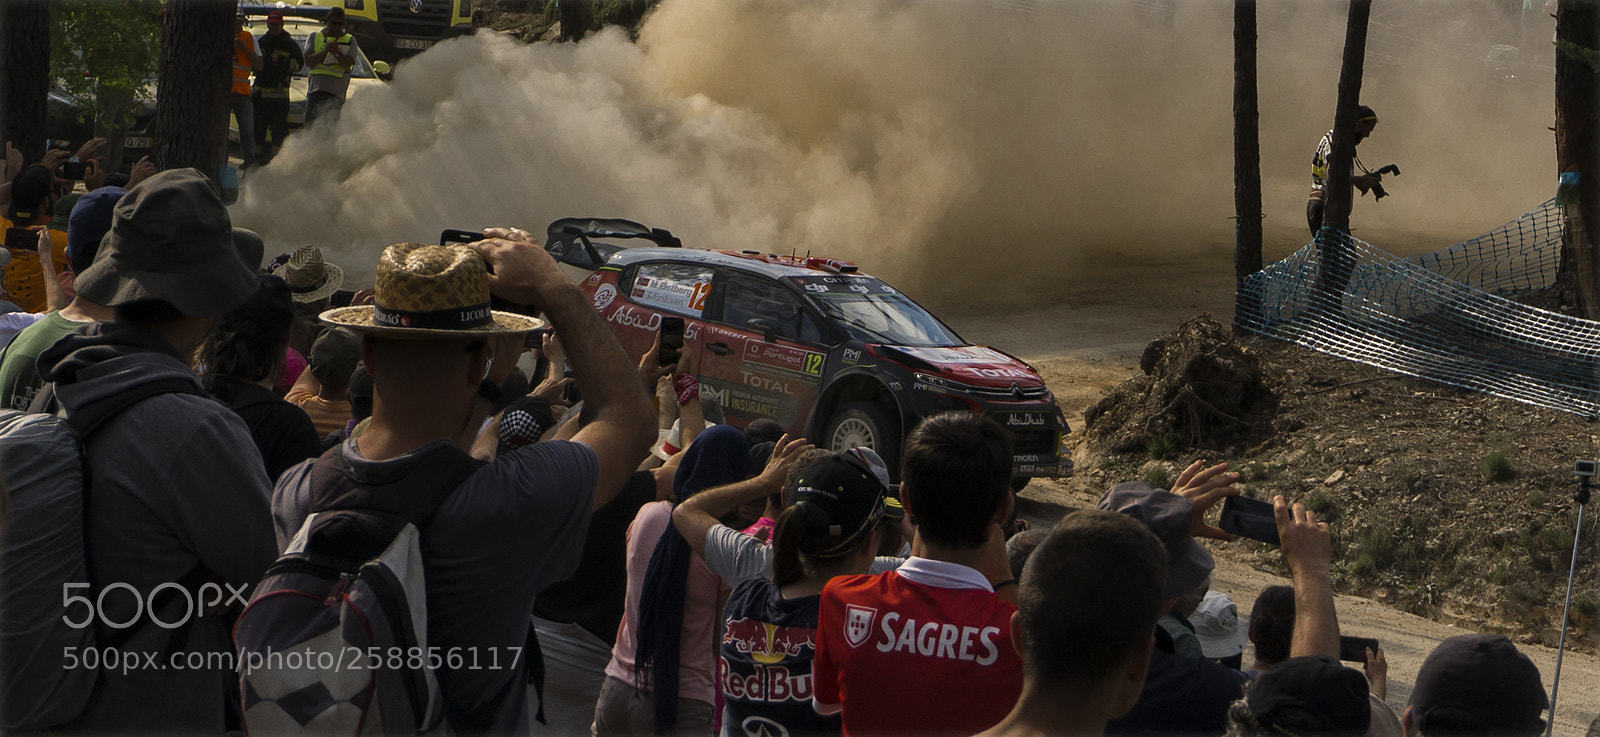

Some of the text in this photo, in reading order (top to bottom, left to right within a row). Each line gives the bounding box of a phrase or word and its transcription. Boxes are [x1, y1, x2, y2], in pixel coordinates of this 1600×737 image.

[688, 282, 713, 311] 12
[763, 350, 802, 364] Portugal
[805, 353, 822, 375] 12
[741, 371, 794, 395] TOTAL
[963, 367, 1037, 379] TOTAL
[732, 398, 778, 418] INSURANCE
[876, 611, 1000, 666] SAGRES
[721, 656, 815, 702] Red Bu
